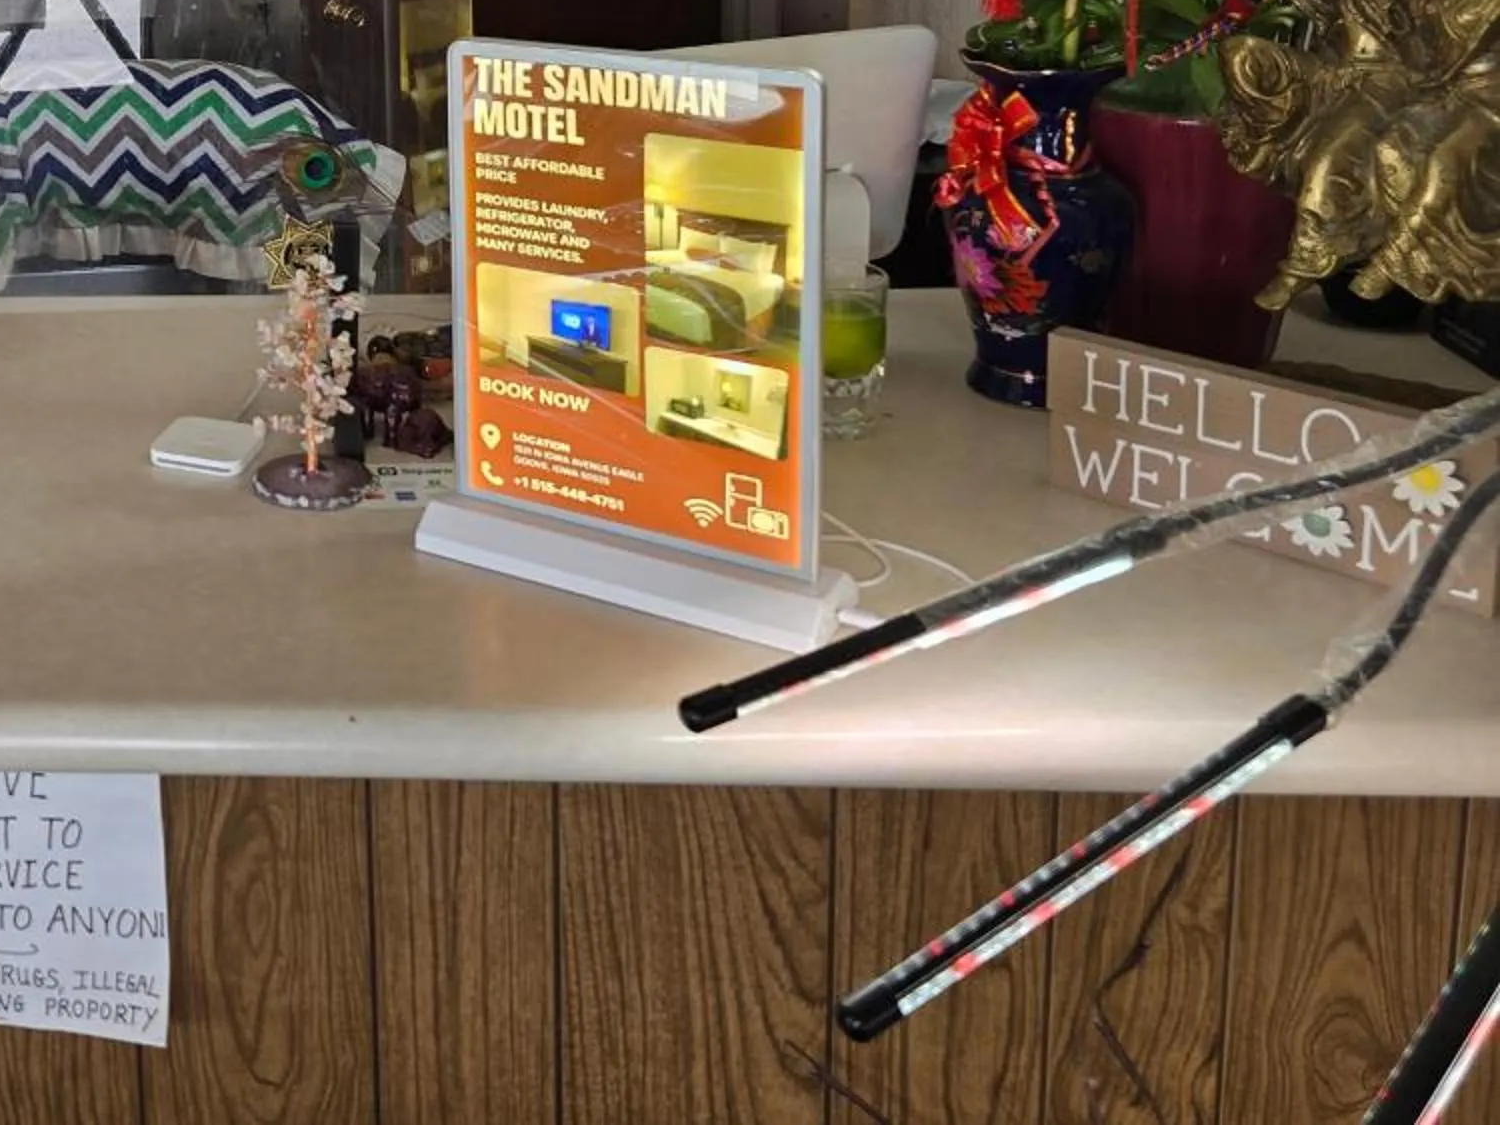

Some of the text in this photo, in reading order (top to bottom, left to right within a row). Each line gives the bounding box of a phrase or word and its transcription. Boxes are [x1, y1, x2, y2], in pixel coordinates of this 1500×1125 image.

[473, 57, 727, 118] THE SANDMAN
[473, 98, 585, 146] MOTEL
[475, 152, 605, 180] BEST AFFORDABLE
[475, 167, 517, 184] PRICE
[475, 192, 609, 224] PROVIDES LAUNDRY,
[475, 207, 576, 233] REFRIGERATOR,
[475, 223, 591, 249] MICROWAVE AND
[476, 238, 585, 264] MANY SERVICES.
[479, 376, 591, 412] BOOK NOW
[1081, 350, 1361, 466] HELLO
[512, 431, 571, 453] LOCATION
[42, 816, 83, 850] TO
[71, 969, 161, 999] ILLEGAL
